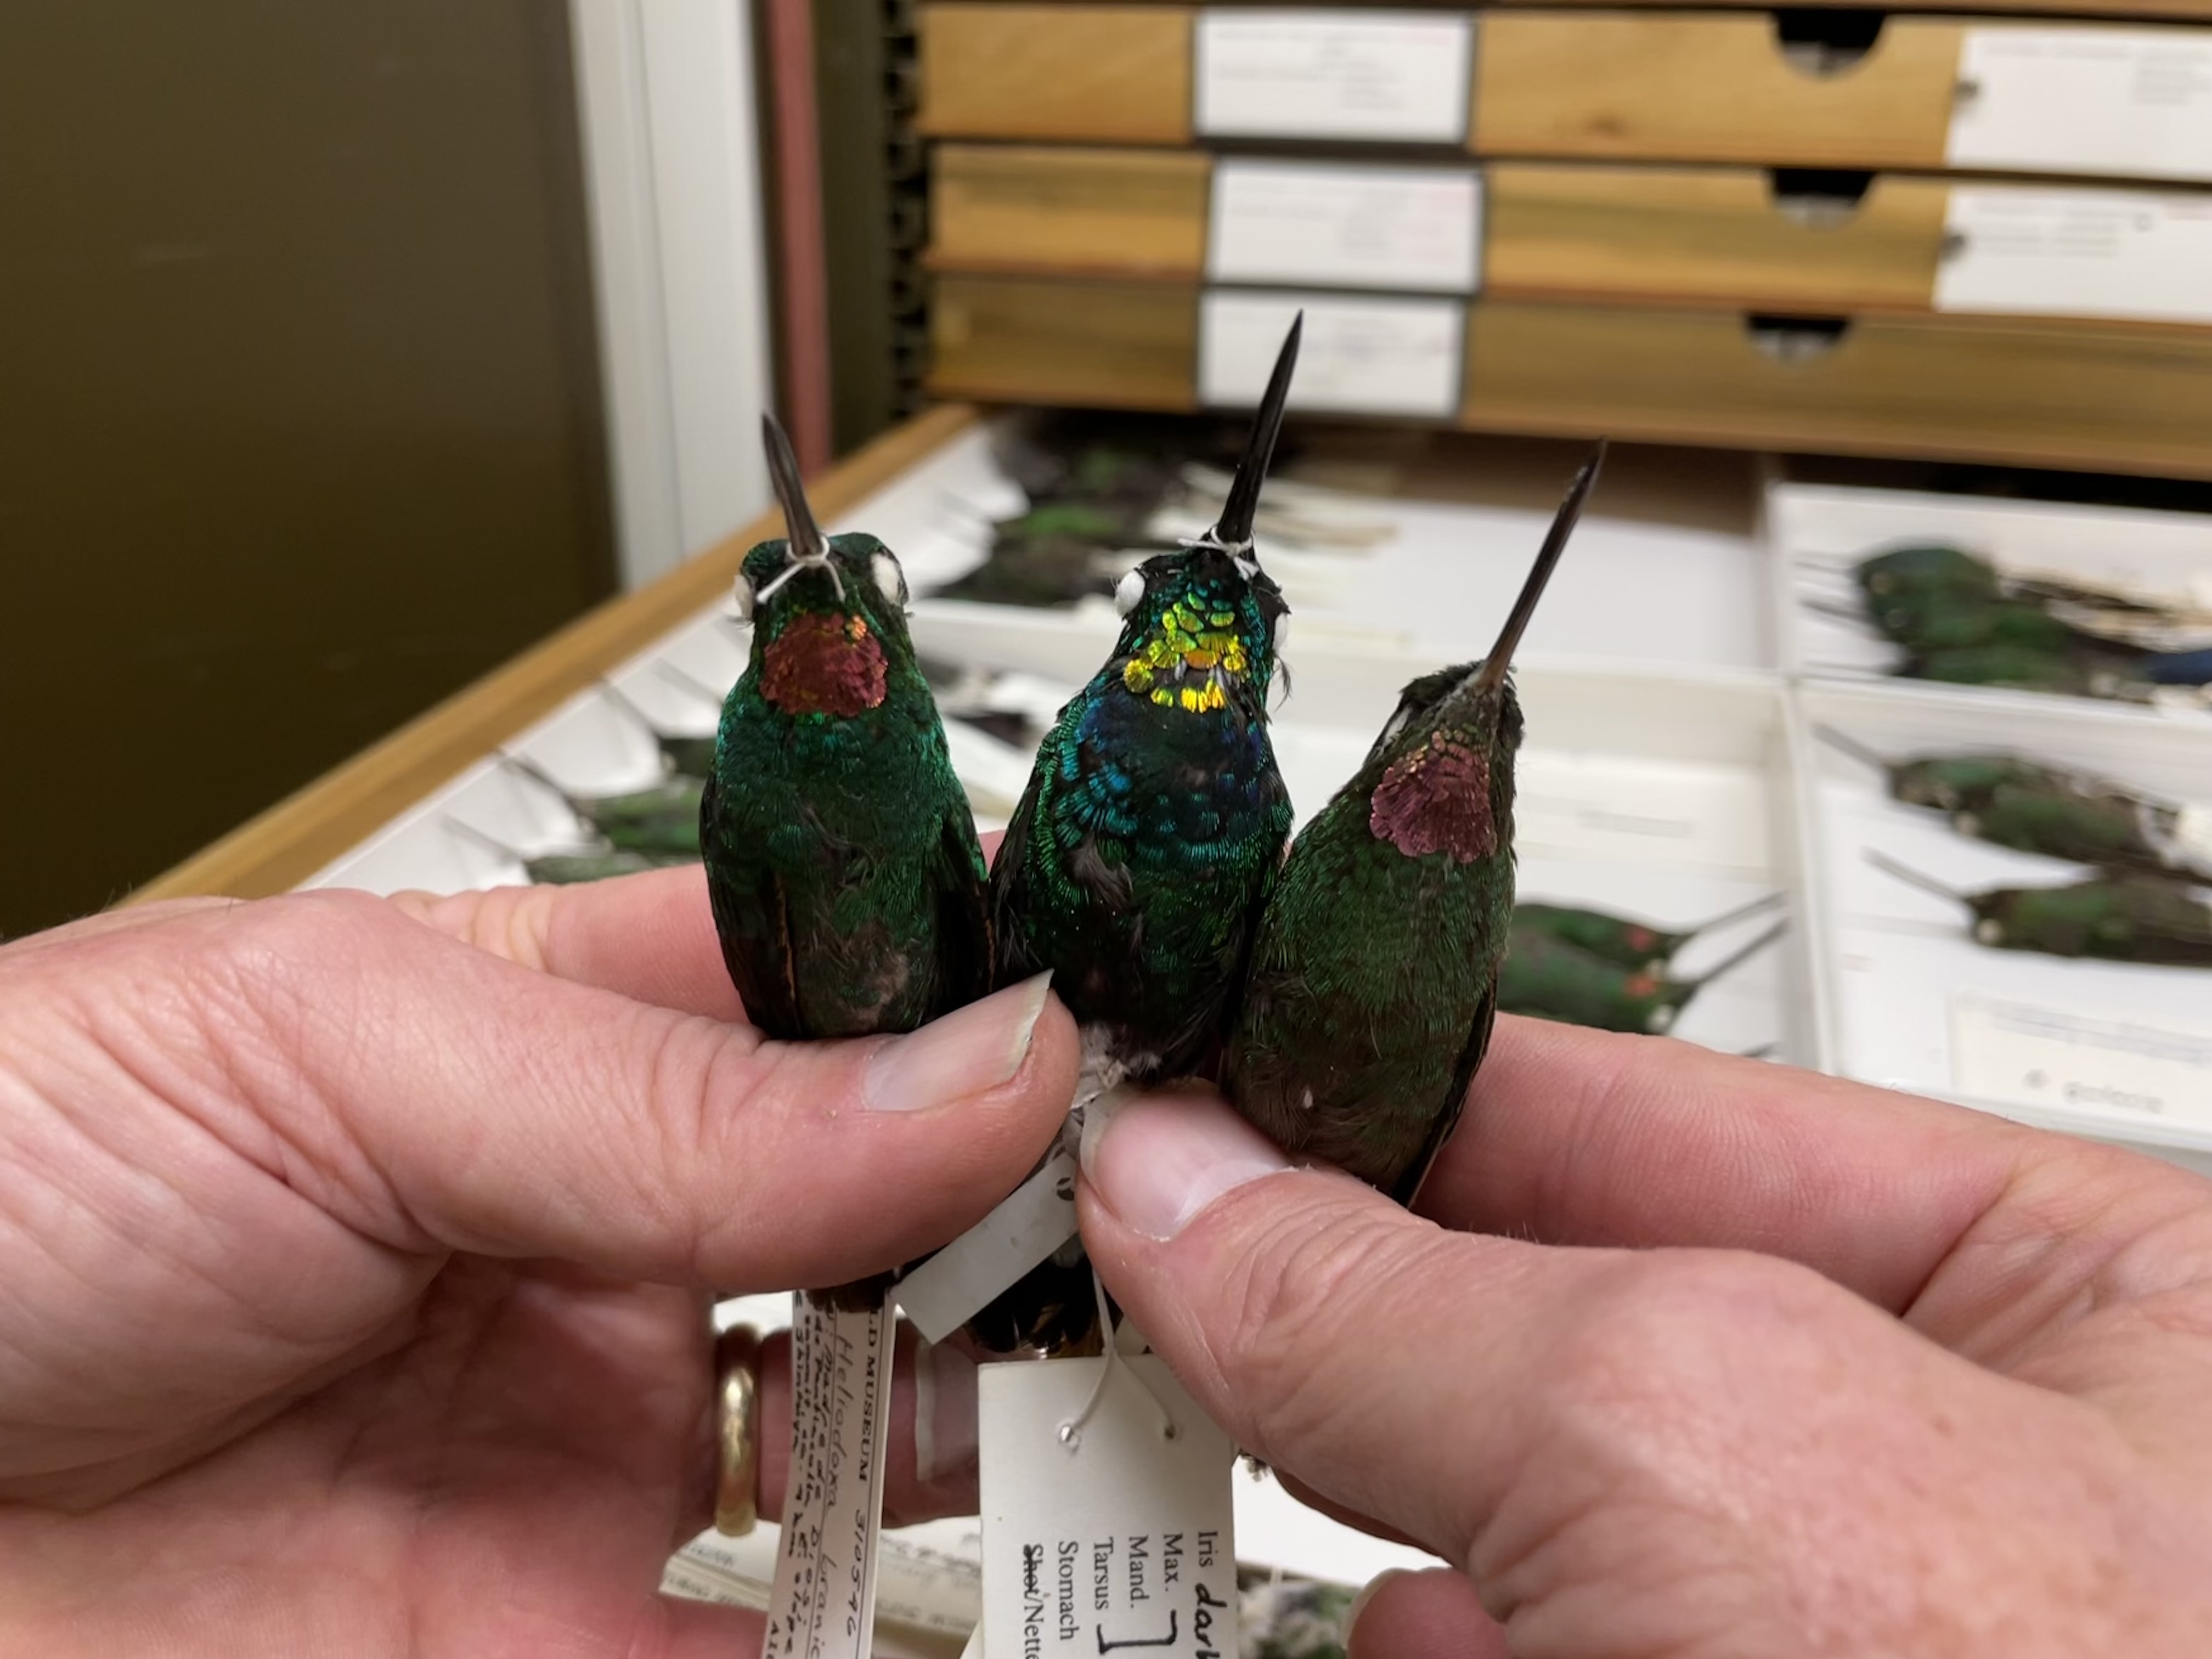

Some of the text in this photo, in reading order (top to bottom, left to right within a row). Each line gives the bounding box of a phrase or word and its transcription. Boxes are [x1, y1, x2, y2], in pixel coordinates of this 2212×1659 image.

[819, 1343, 833, 1447] Madre
[825, 1335, 854, 1513] Heliodoxa
[859, 1356, 876, 1481] MUSEUM
[815, 1459, 825, 1499] de
[847, 1509, 866, 1637] 310546
[1057, 1541, 1080, 1640] Stomach
[1093, 1536, 1114, 1610] Tarsus
[1128, 1534, 1150, 1609] Mand.
[1163, 1533, 1184, 1592] Max.
[1197, 1531, 1218, 1568] Iris
